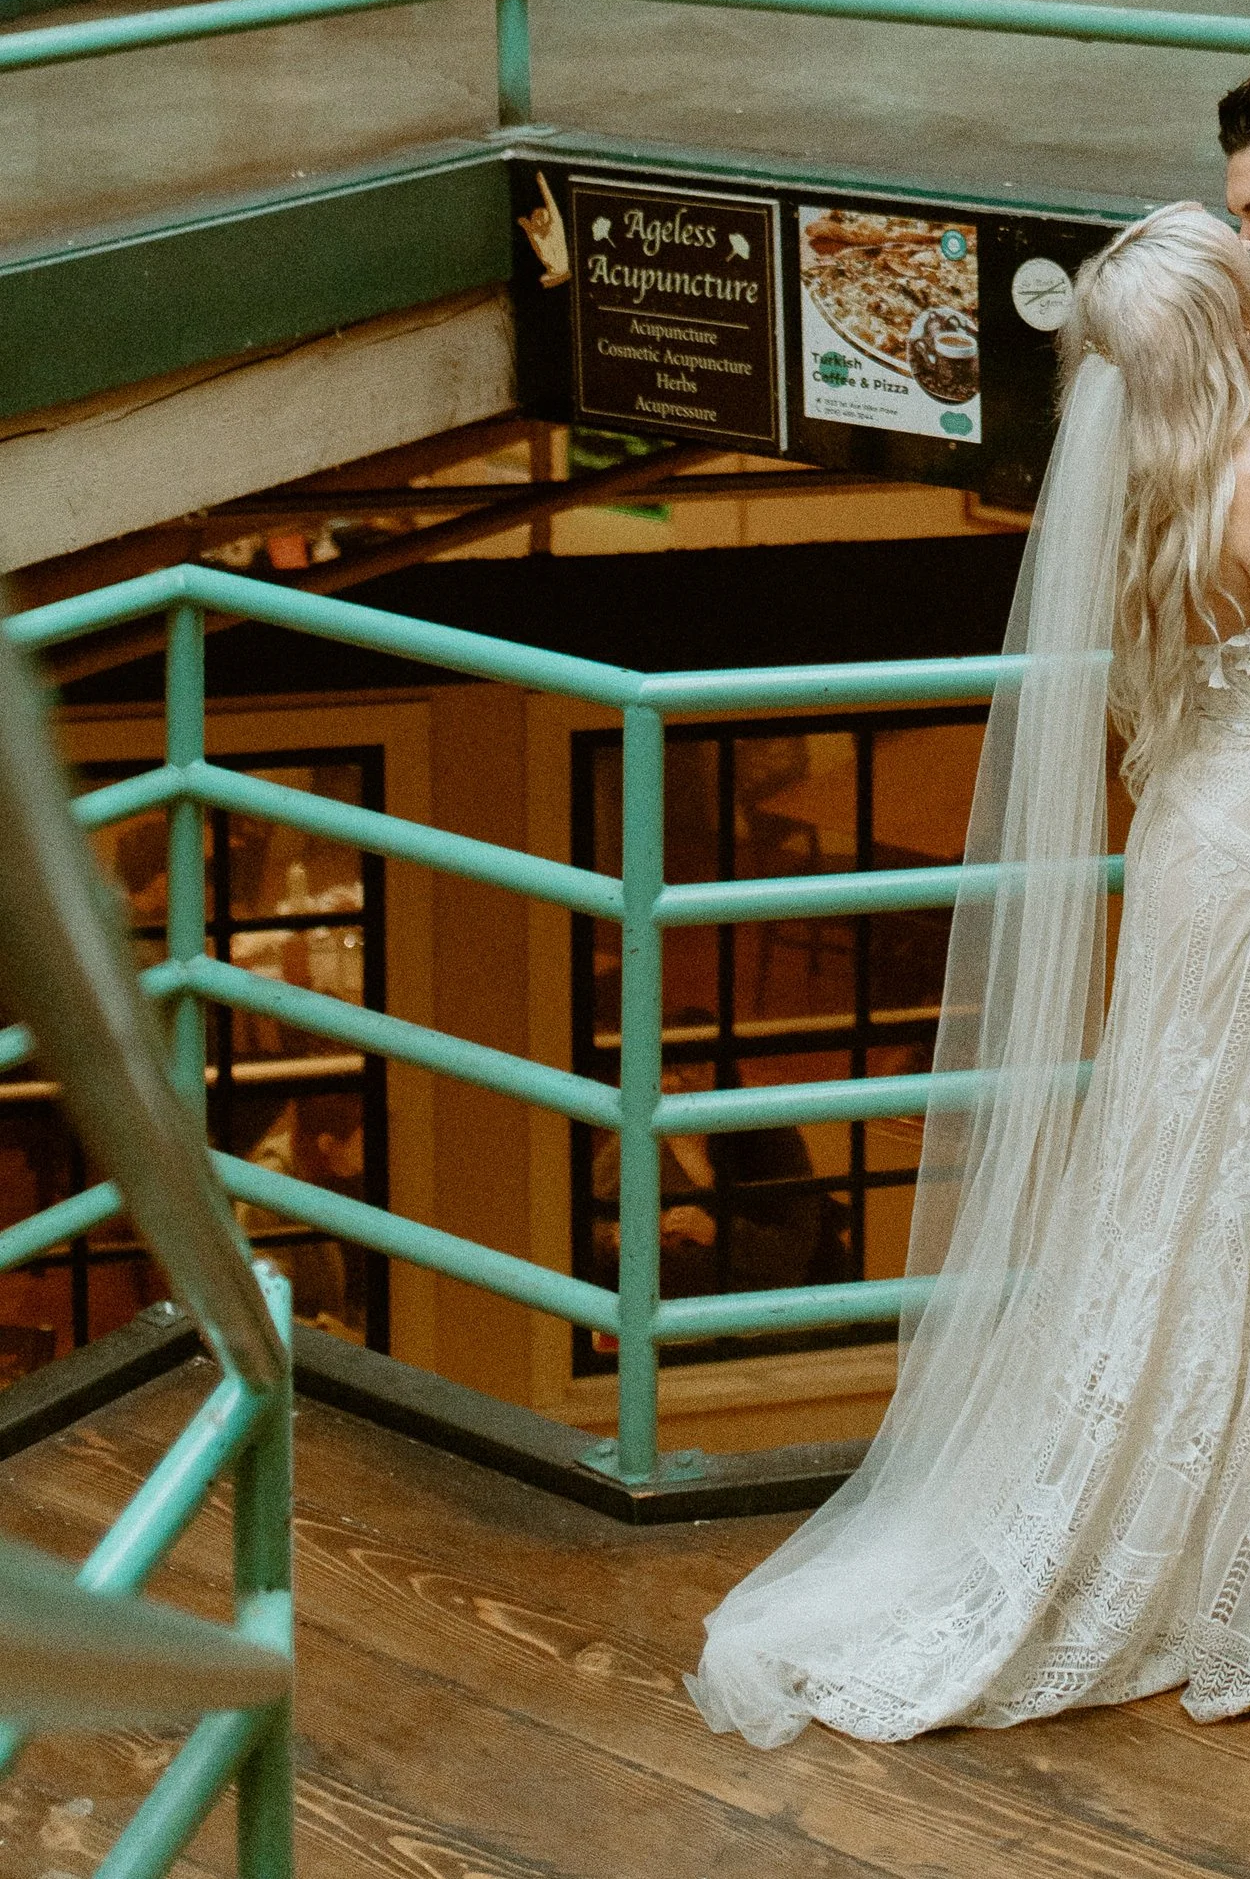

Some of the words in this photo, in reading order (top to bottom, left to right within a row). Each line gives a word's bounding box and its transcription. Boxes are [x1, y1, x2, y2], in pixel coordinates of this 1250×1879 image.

[624, 208, 718, 256] Ageless
[588, 254, 759, 305] Acupuncture
[630, 319, 719, 345] Acupuncture
[597, 337, 660, 363] Cosmetic
[663, 349, 753, 376] Acupuncture
[811, 351, 863, 371] Turkish
[656, 372, 698, 394] Herbs
[812, 370, 857, 388] Coffee
[860, 377, 870, 389] &
[873, 378, 910, 396] Pizza
[635, 394, 718, 422] Acupressure
